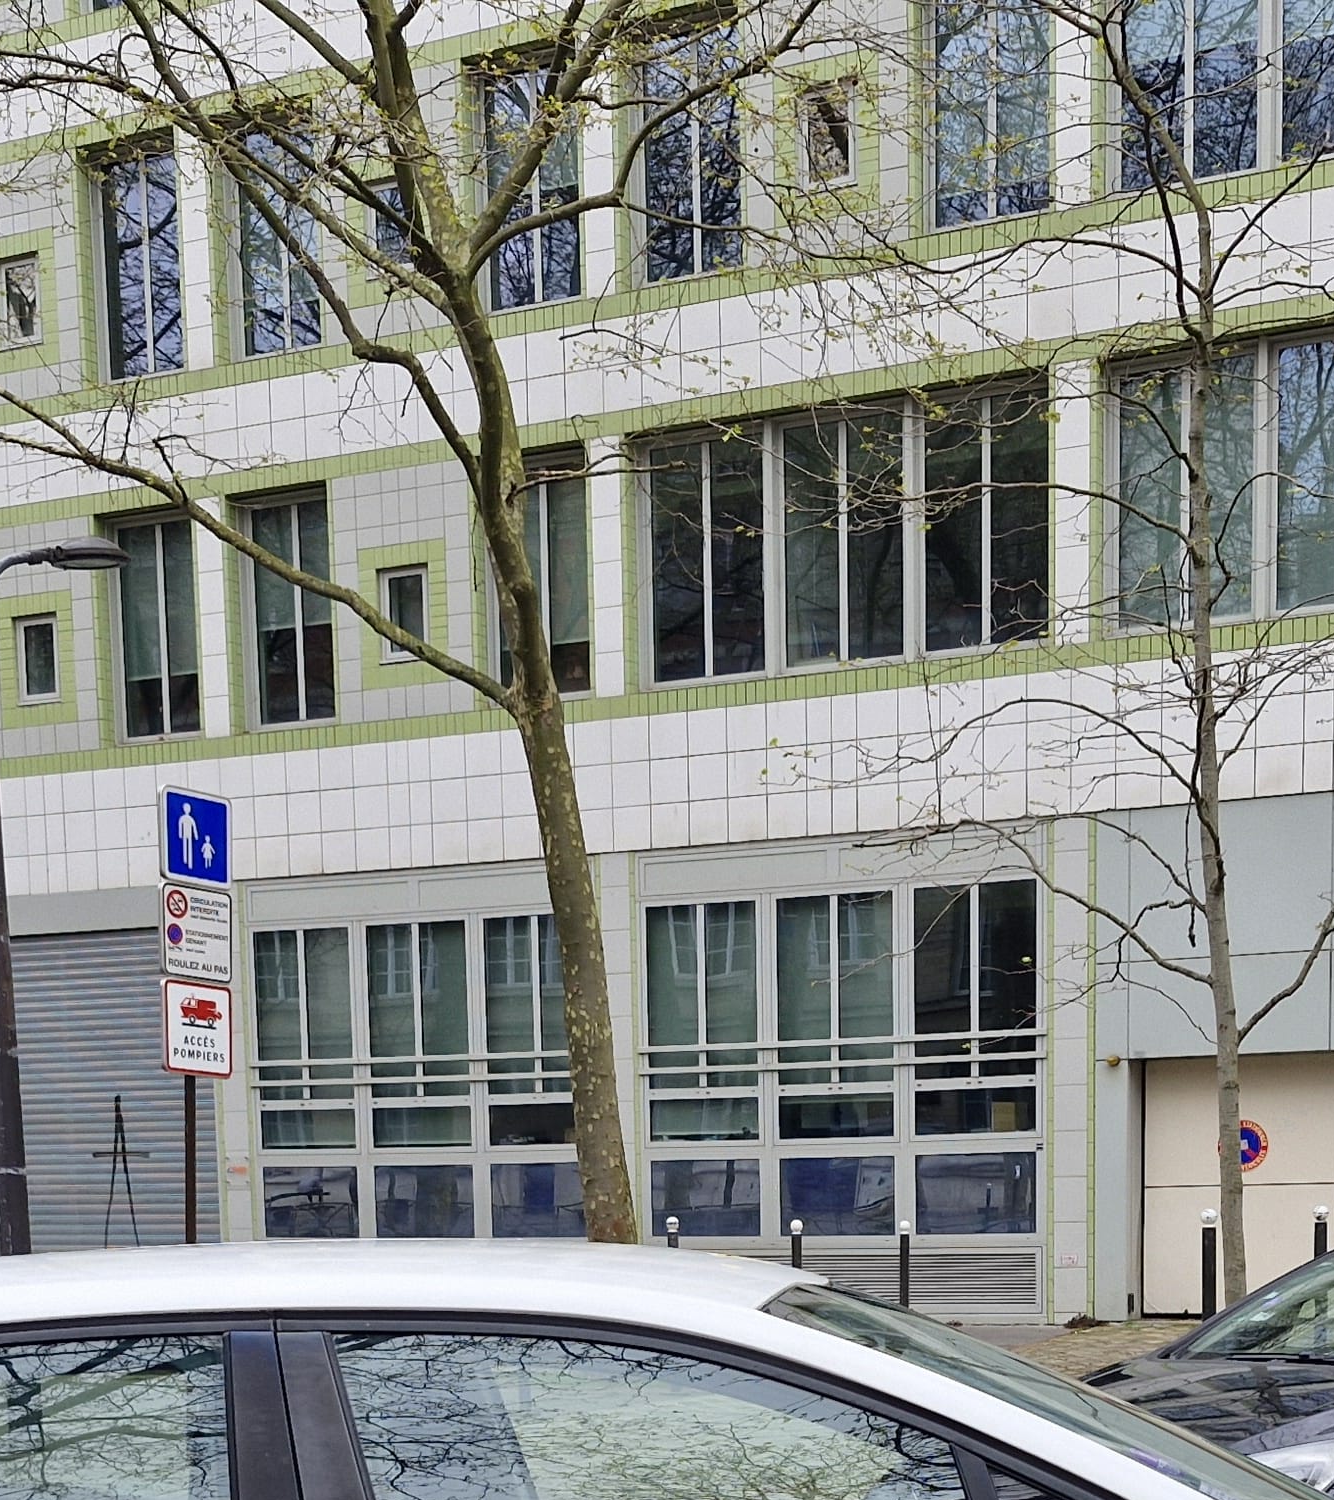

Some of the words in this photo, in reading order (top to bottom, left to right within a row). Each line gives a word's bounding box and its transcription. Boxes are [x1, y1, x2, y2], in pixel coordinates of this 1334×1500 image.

[168, 958, 200, 971] ROULEZ
[201, 963, 213, 973] AU
[214, 965, 229, 975] PAS
[173, 1047, 226, 1064] POMPIERS
